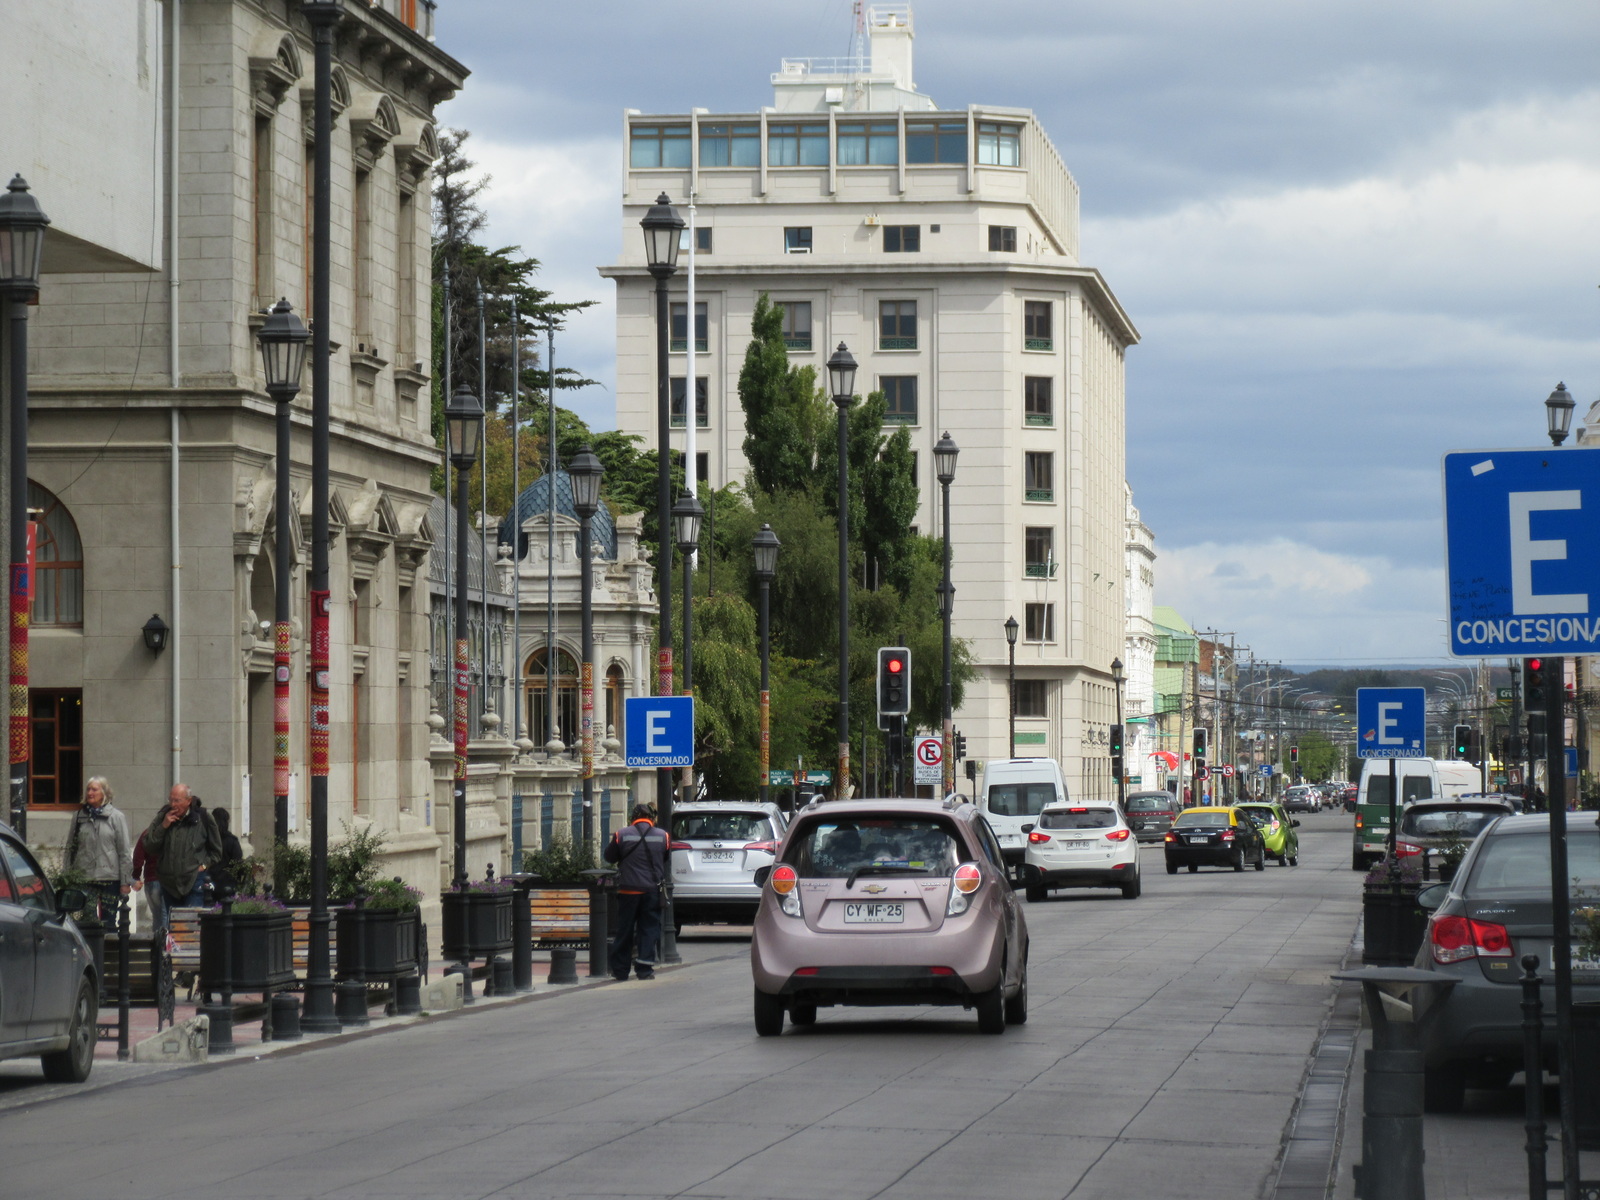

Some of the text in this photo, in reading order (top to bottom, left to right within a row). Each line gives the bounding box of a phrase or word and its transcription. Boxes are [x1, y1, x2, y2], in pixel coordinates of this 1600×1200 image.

[1508, 489, 1588, 615] E
[646, 710, 672, 753] E
[1378, 702, 1404, 745] E
[627, 755, 690, 765] CONCESIONADO
[1360, 748, 1423, 758] CONCESIONADO
